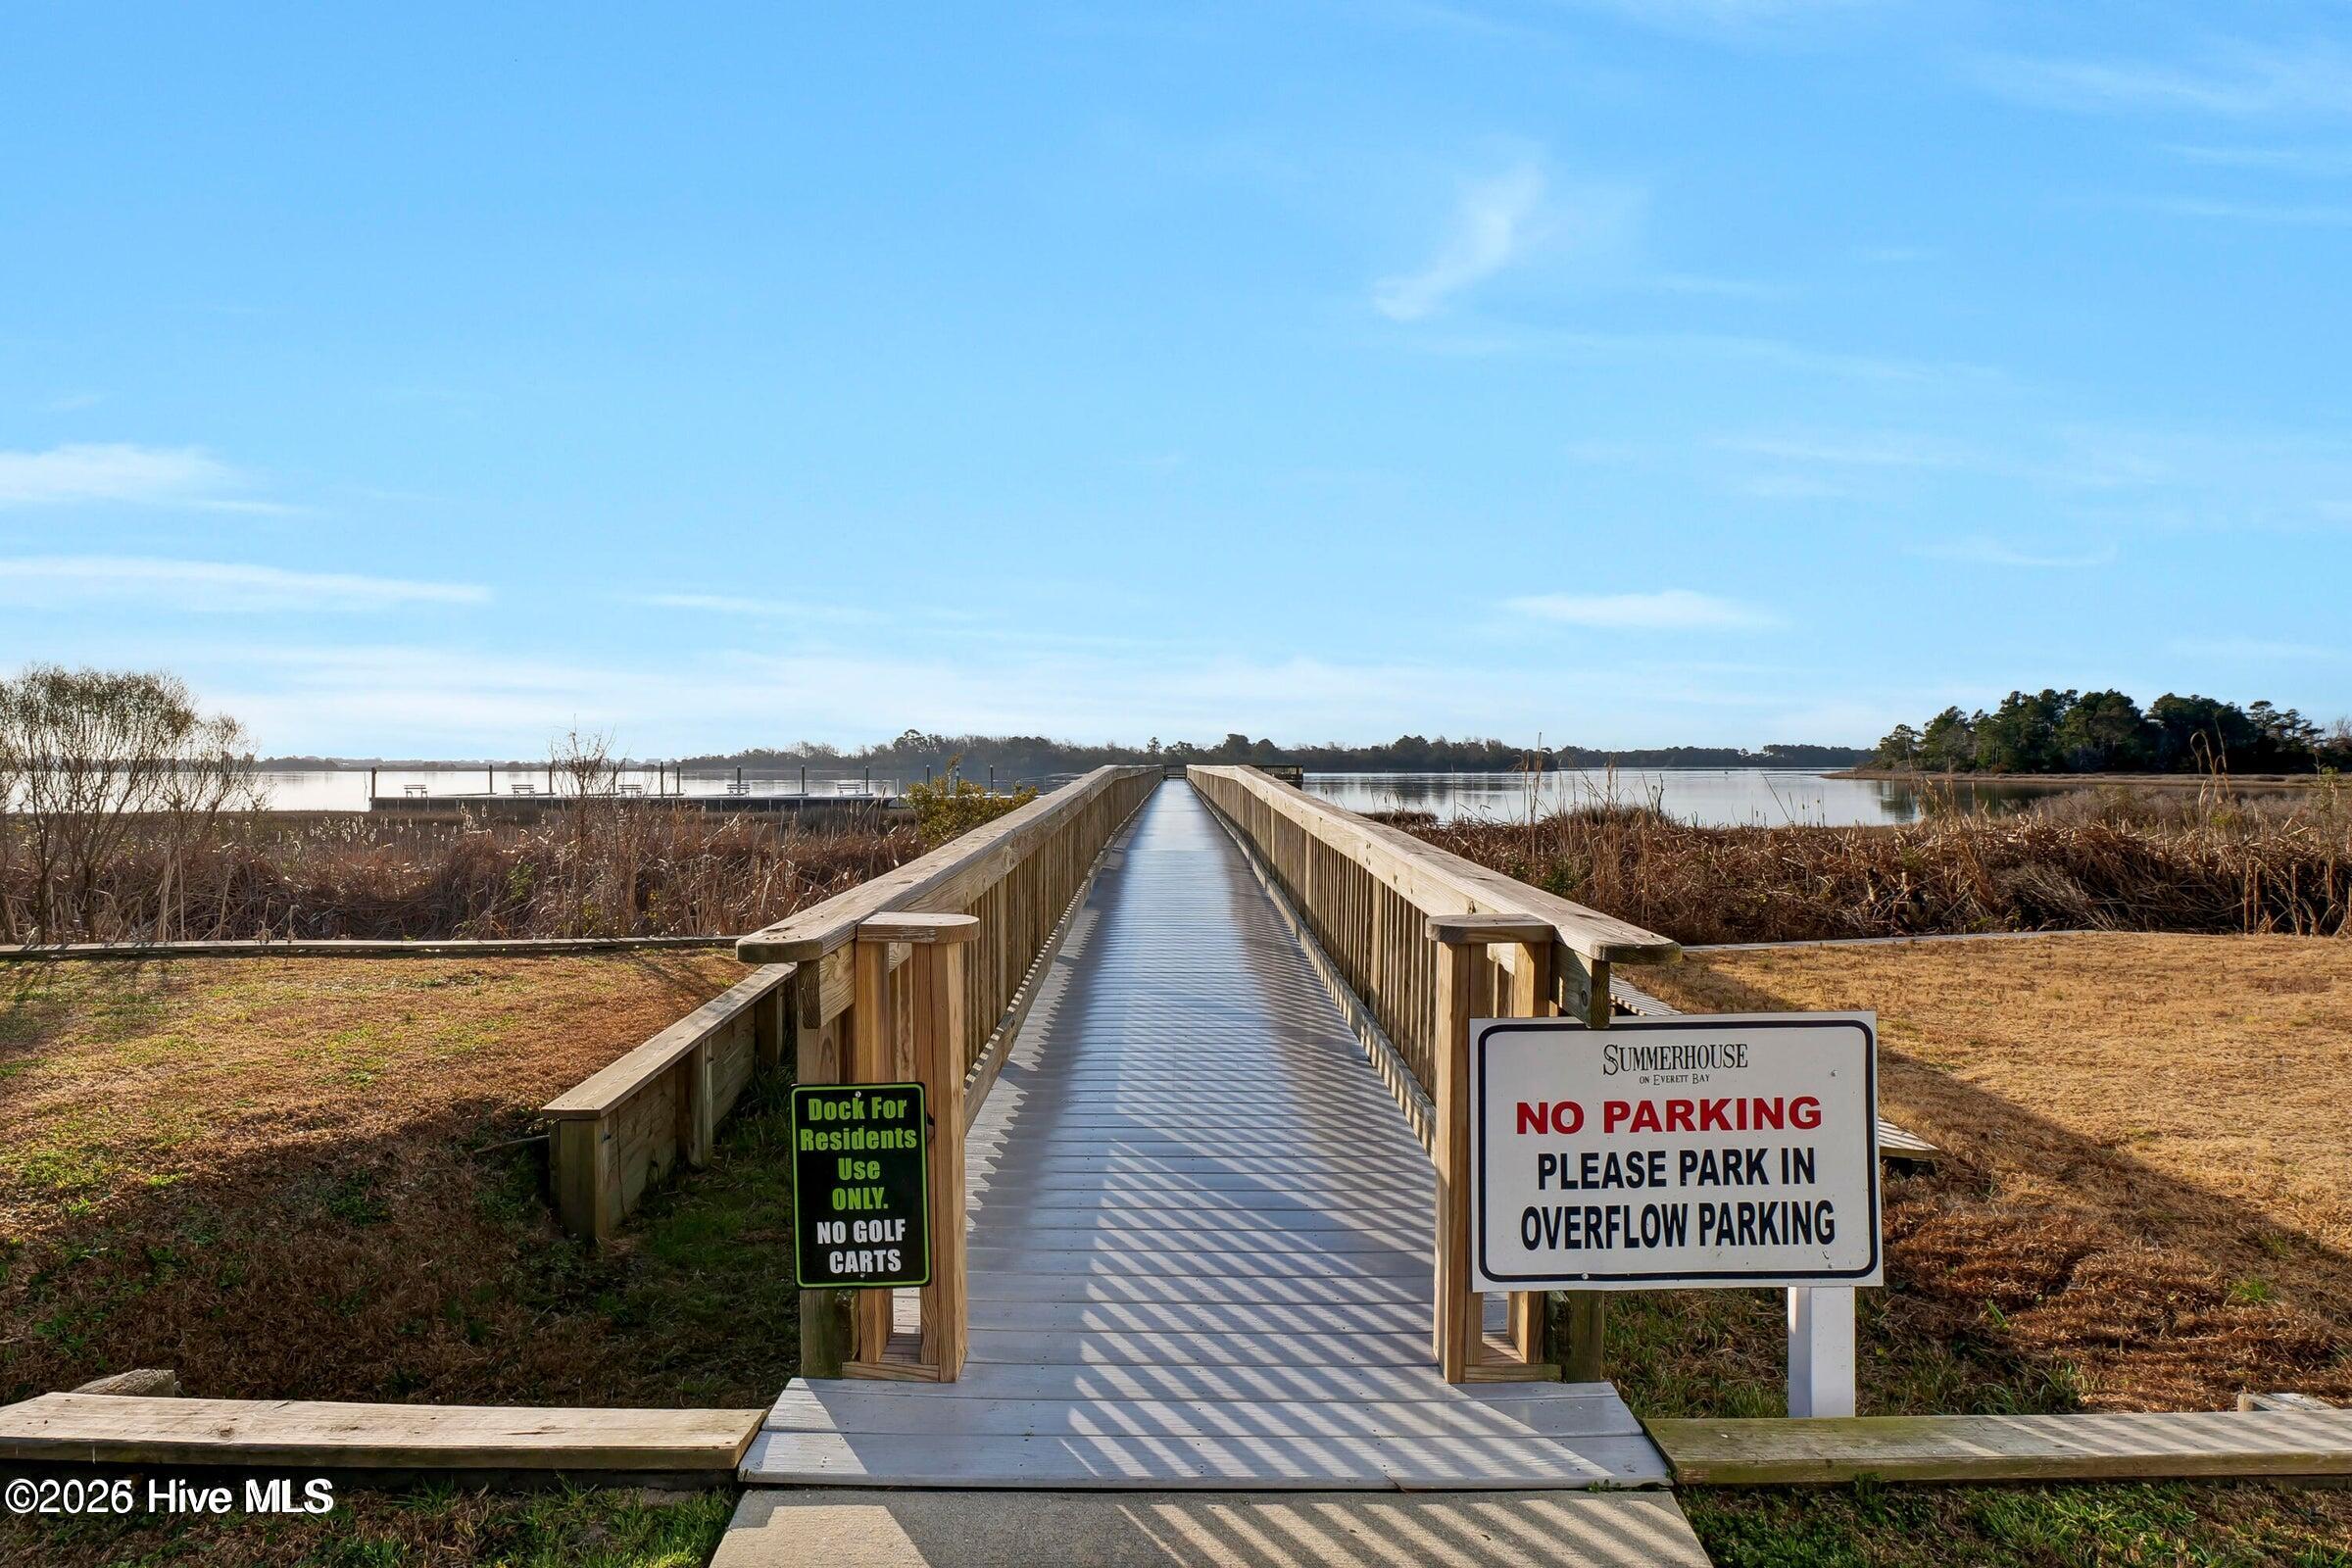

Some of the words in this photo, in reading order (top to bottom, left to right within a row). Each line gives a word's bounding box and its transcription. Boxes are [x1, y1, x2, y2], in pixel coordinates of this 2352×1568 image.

[1602, 1043, 1748, 1076] SUMMERHOUSE
[1639, 1075, 1650, 1085] ON
[1652, 1074, 1689, 1086] EVERETT
[1691, 1073, 1710, 1086] BAY
[808, 1097, 865, 1121] Dock
[871, 1097, 907, 1119] For
[1516, 1101, 1585, 1135] NO
[1603, 1096, 1822, 1134] PARKING
[800, 1127, 917, 1152] Residents
[838, 1157, 881, 1180] Use
[1537, 1151, 1666, 1191] PLEASE
[1679, 1148, 1769, 1187] PARK
[1781, 1147, 1815, 1185] IN
[832, 1187, 889, 1210] ONLY.
[816, 1221, 847, 1245] NO
[853, 1219, 906, 1243] GOLF
[1521, 1202, 1688, 1250] OVERFLOW
[1698, 1200, 1836, 1247] PARKING
[829, 1250, 902, 1274] CARTS
